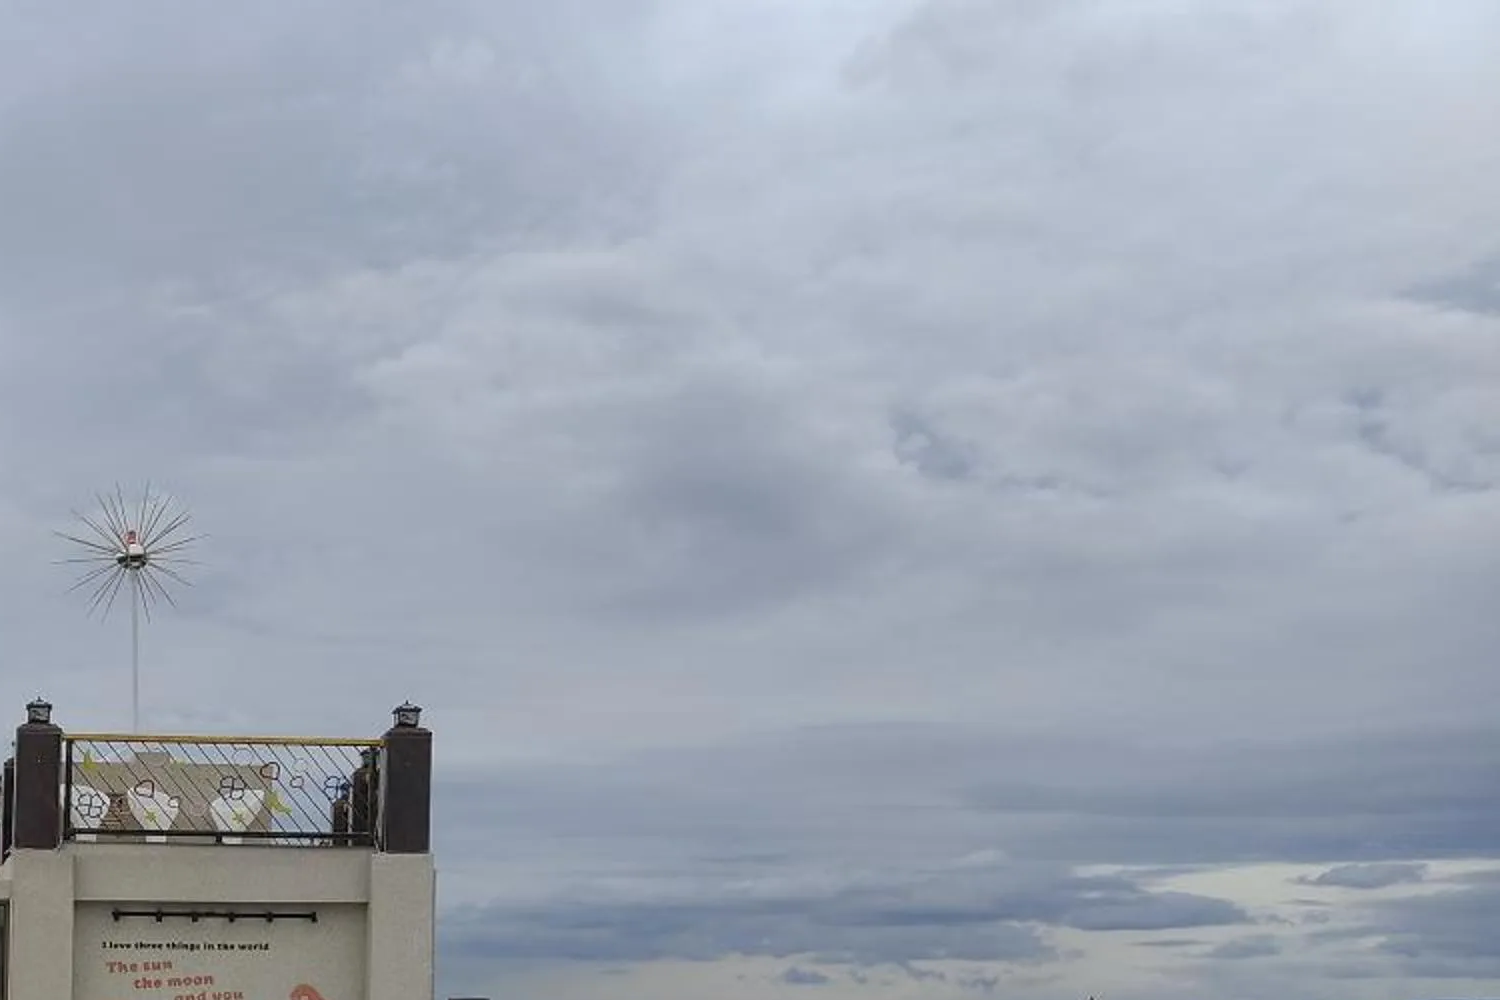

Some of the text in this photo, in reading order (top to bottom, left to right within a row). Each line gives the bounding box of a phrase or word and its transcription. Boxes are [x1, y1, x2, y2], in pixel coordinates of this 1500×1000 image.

[109, 941, 132, 949] love
[135, 941, 163, 950] three
[166, 941, 201, 952] things
[204, 941, 215, 950] in
[238, 941, 269, 951] world
[106, 959, 173, 974] The sun
[133, 974, 214, 990] the moon
